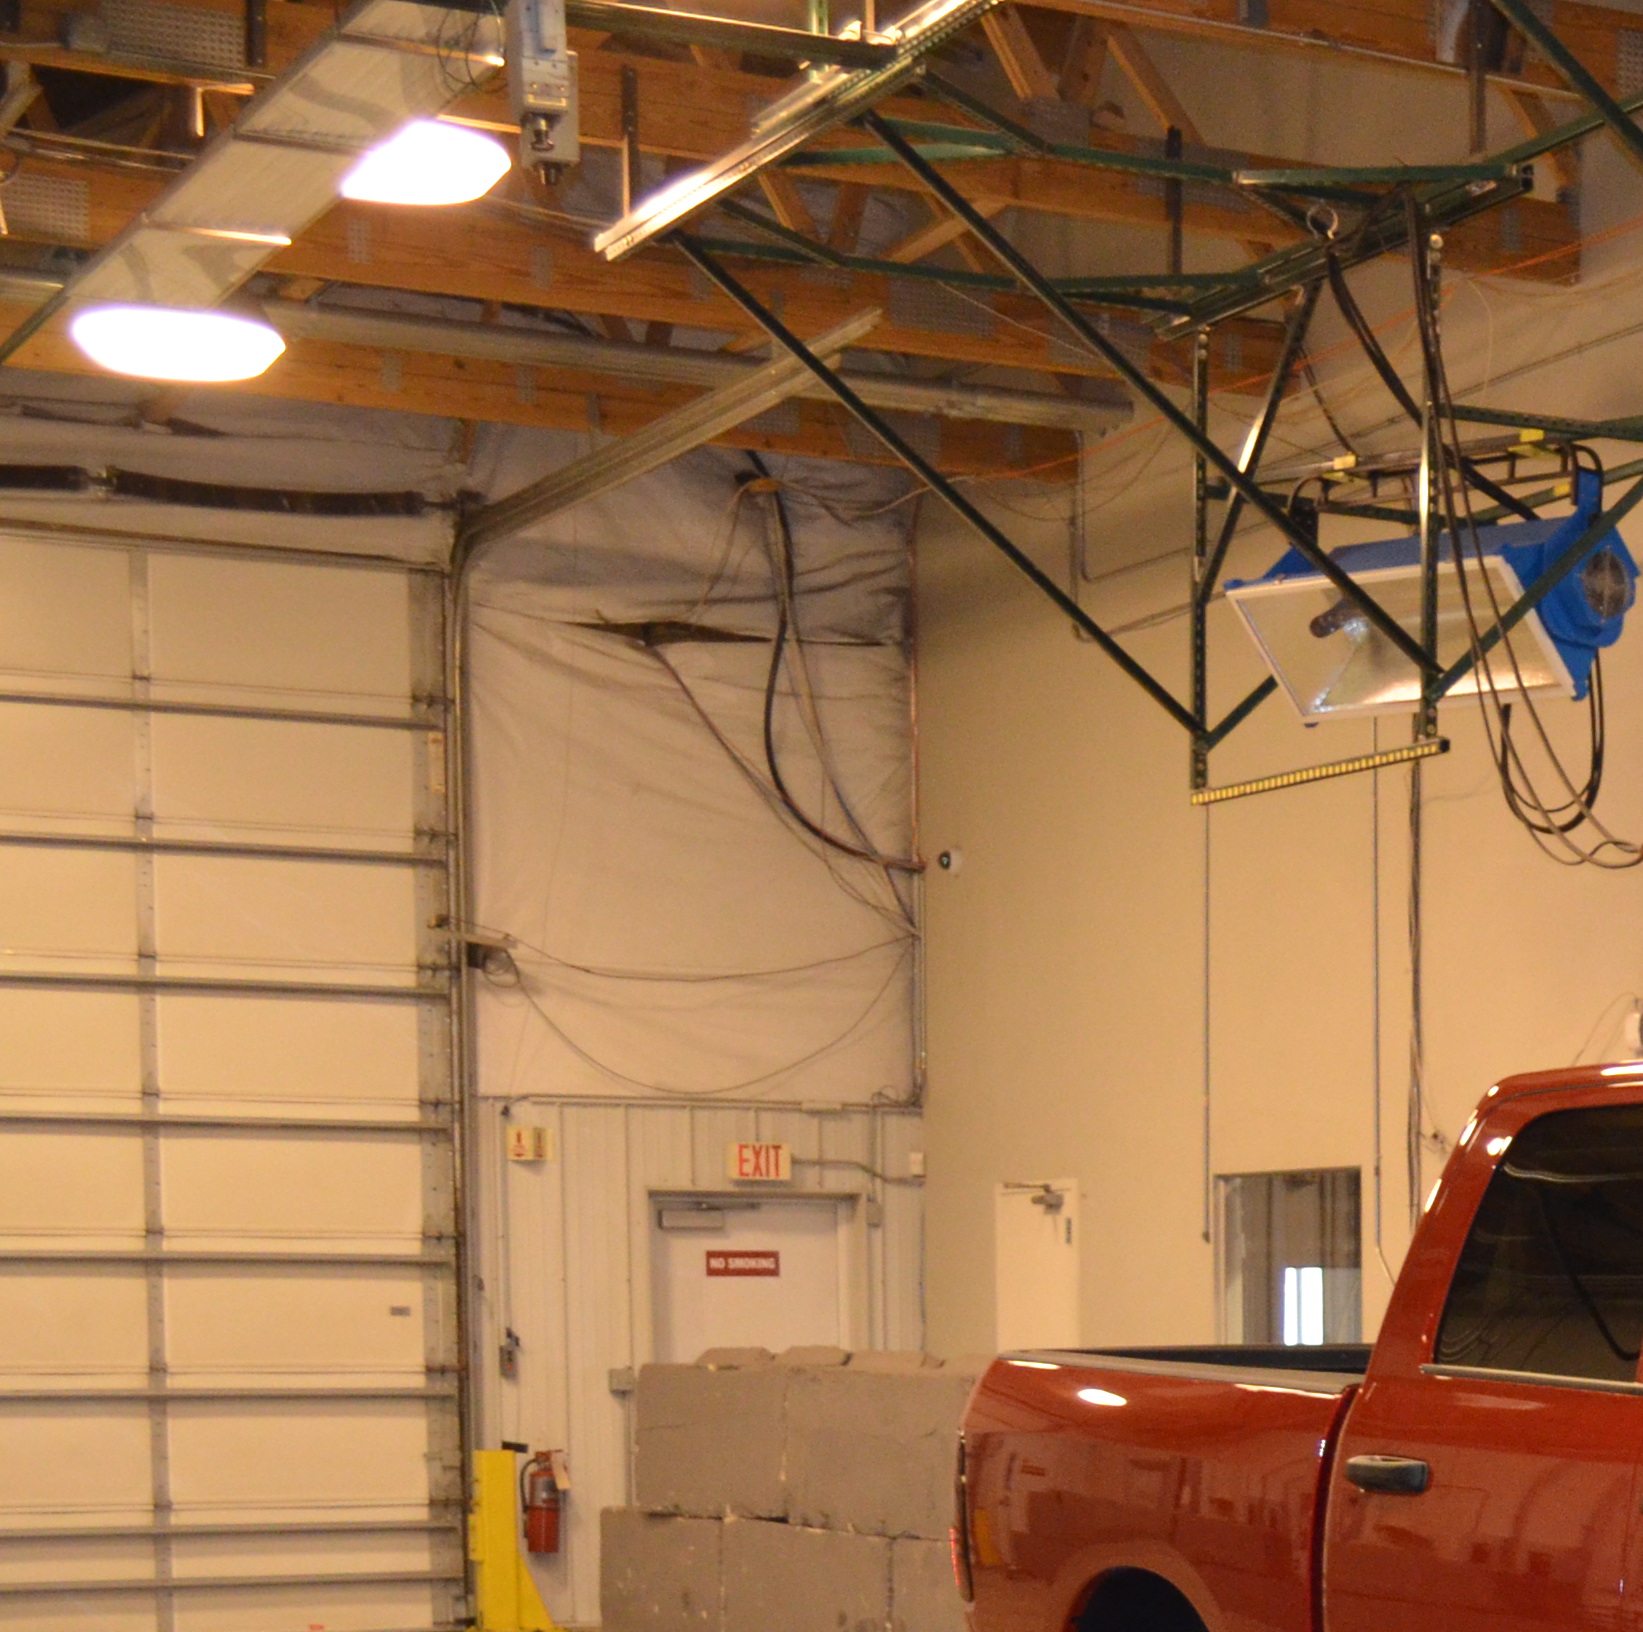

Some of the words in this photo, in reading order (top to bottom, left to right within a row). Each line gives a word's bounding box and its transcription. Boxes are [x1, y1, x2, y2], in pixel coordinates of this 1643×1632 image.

[737, 1143, 783, 1178] EXIT
[709, 1257, 726, 1269] NO
[727, 1257, 777, 1269] SMOKING
